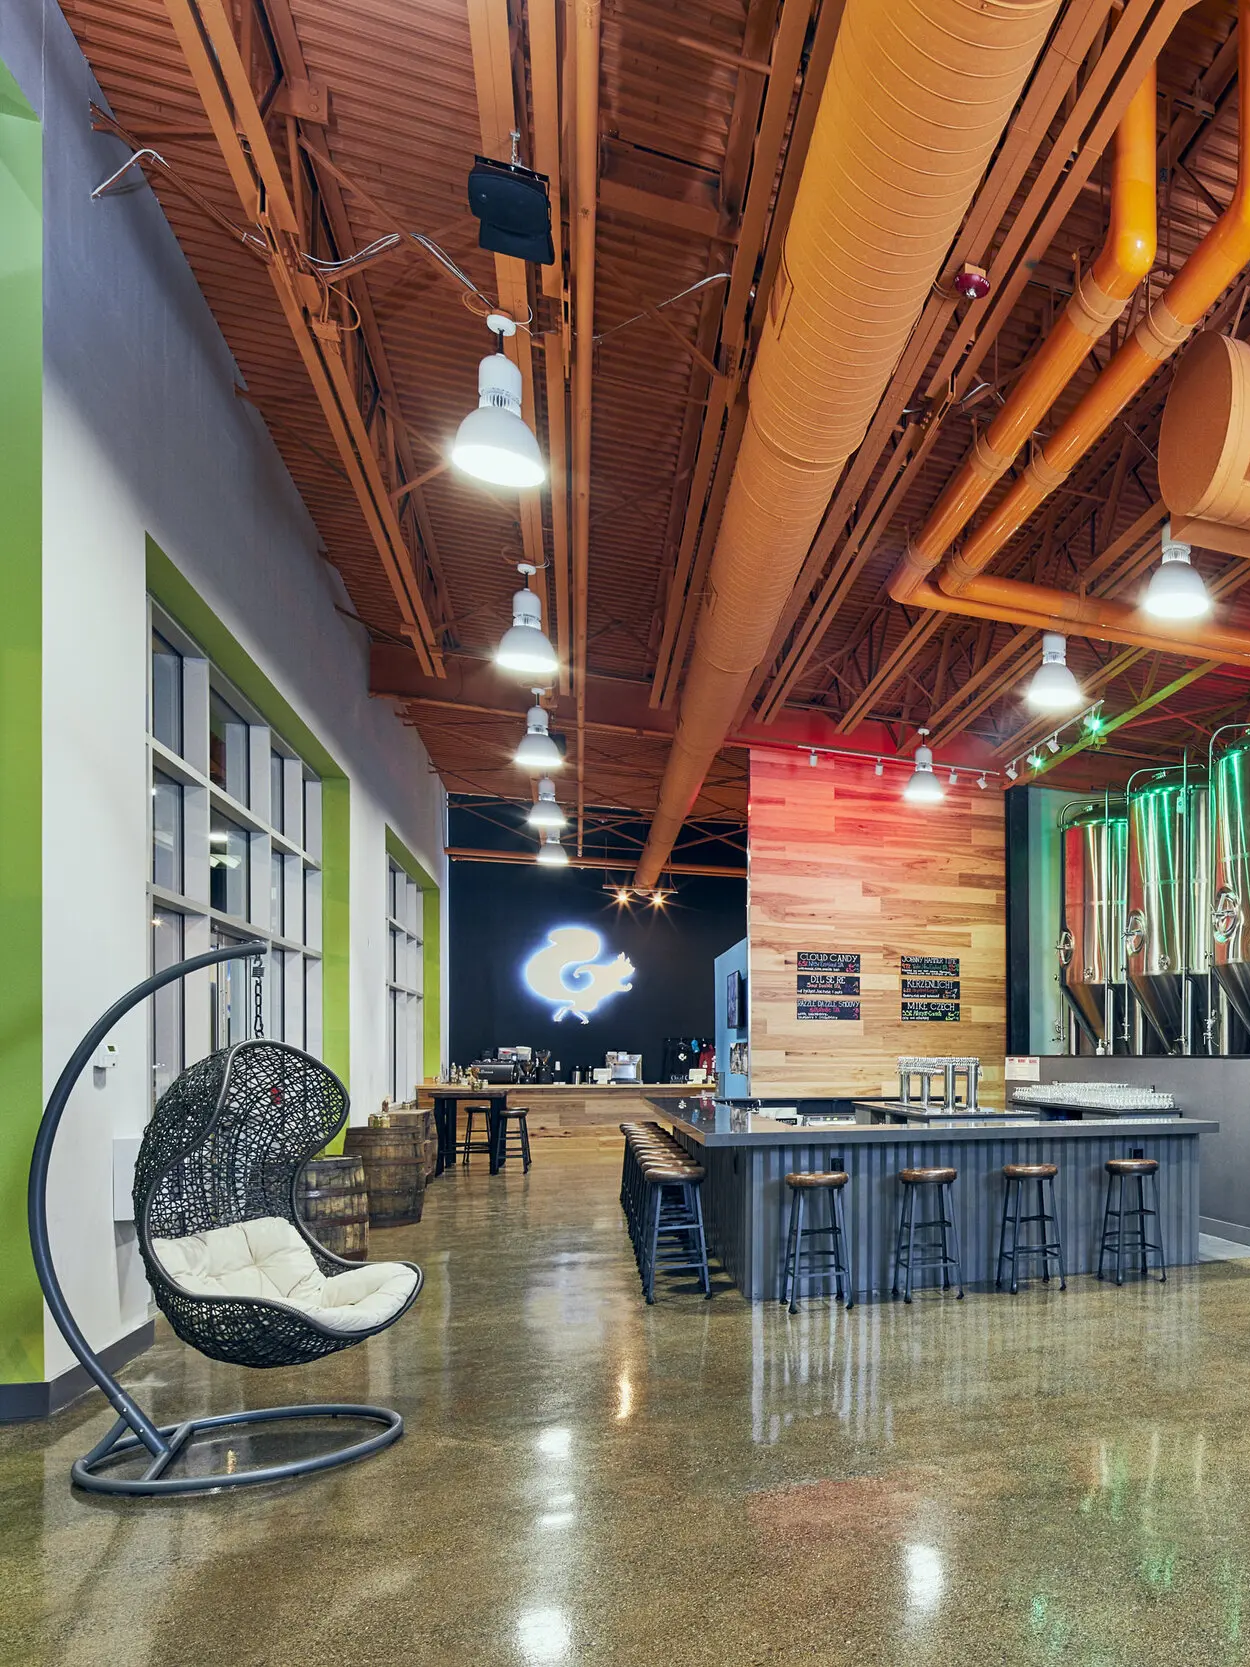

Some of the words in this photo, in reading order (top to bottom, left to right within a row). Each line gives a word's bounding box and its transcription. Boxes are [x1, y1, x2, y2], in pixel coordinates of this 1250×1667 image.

[830, 954, 858, 962] CANDY
[810, 975, 824, 984] DIL
[825, 975, 835, 984] SE
[836, 976, 846, 985] RE
[907, 980, 954, 988] KERZENLICHT
[907, 1002, 928, 1010] MIKE
[930, 1002, 955, 1011] CZECH
